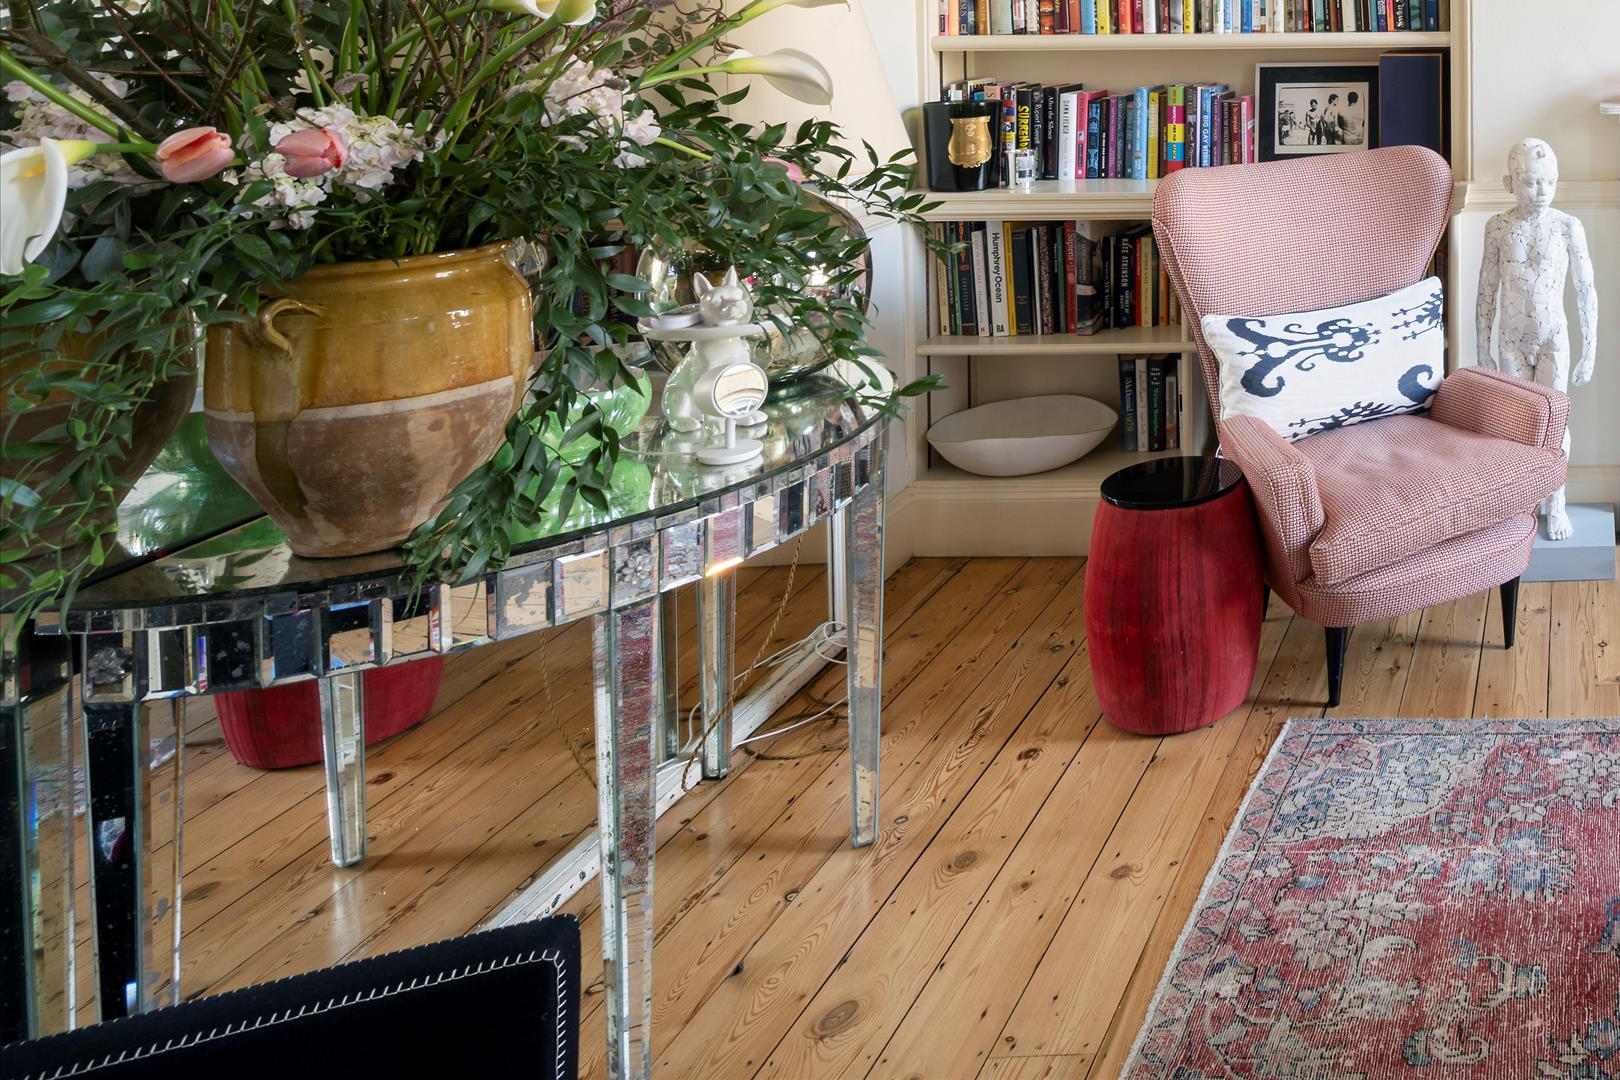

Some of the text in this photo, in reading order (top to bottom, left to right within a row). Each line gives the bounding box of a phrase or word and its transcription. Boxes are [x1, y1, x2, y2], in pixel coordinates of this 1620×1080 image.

[1033, 104, 1042, 124] Rupert
[1067, 233, 1075, 261] Sapiens
[992, 232, 1002, 303] Humphrey Ocean
[1121, 255, 1129, 287] ATKINSON
